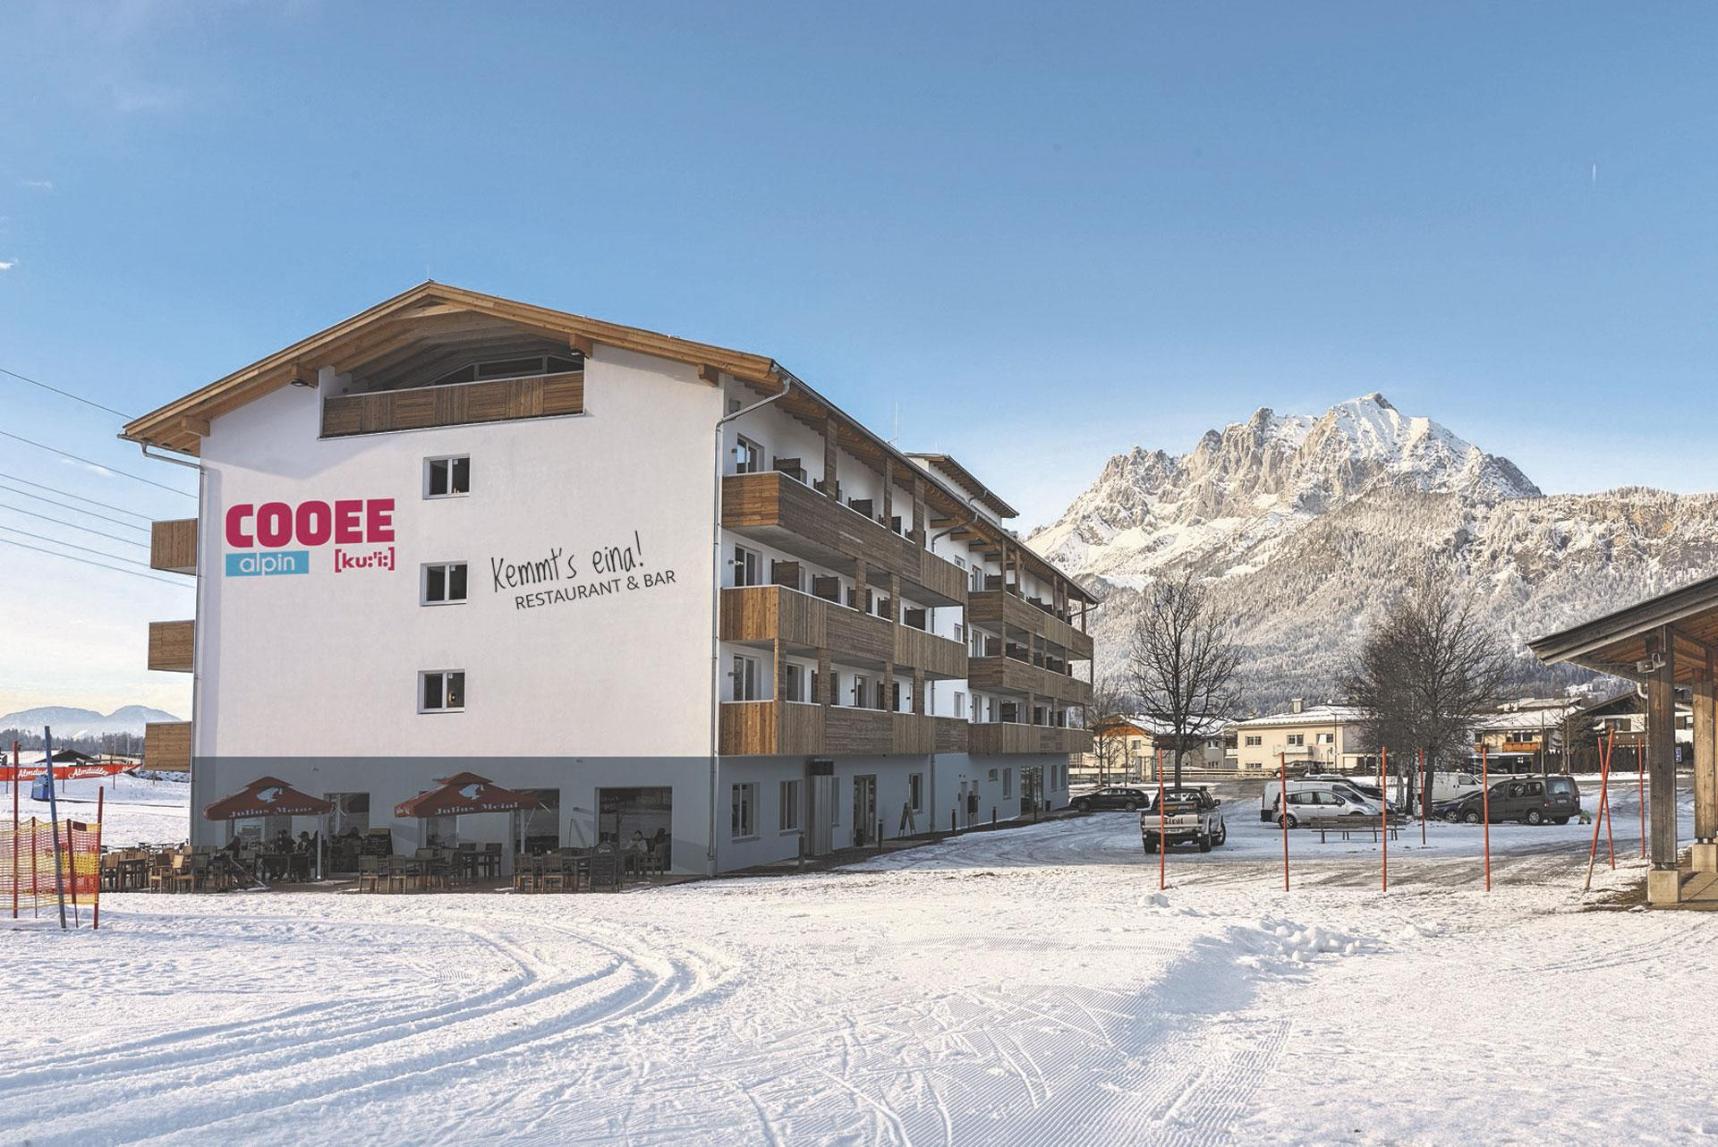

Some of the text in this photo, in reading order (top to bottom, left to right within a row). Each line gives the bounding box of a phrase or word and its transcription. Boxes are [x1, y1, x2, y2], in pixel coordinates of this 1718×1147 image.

[225, 498, 395, 548] COOEE
[240, 552, 295, 576] alpin
[491, 530, 643, 592] Kemmt's eina!
[515, 570, 676, 610] RESTAURANT & BAR
